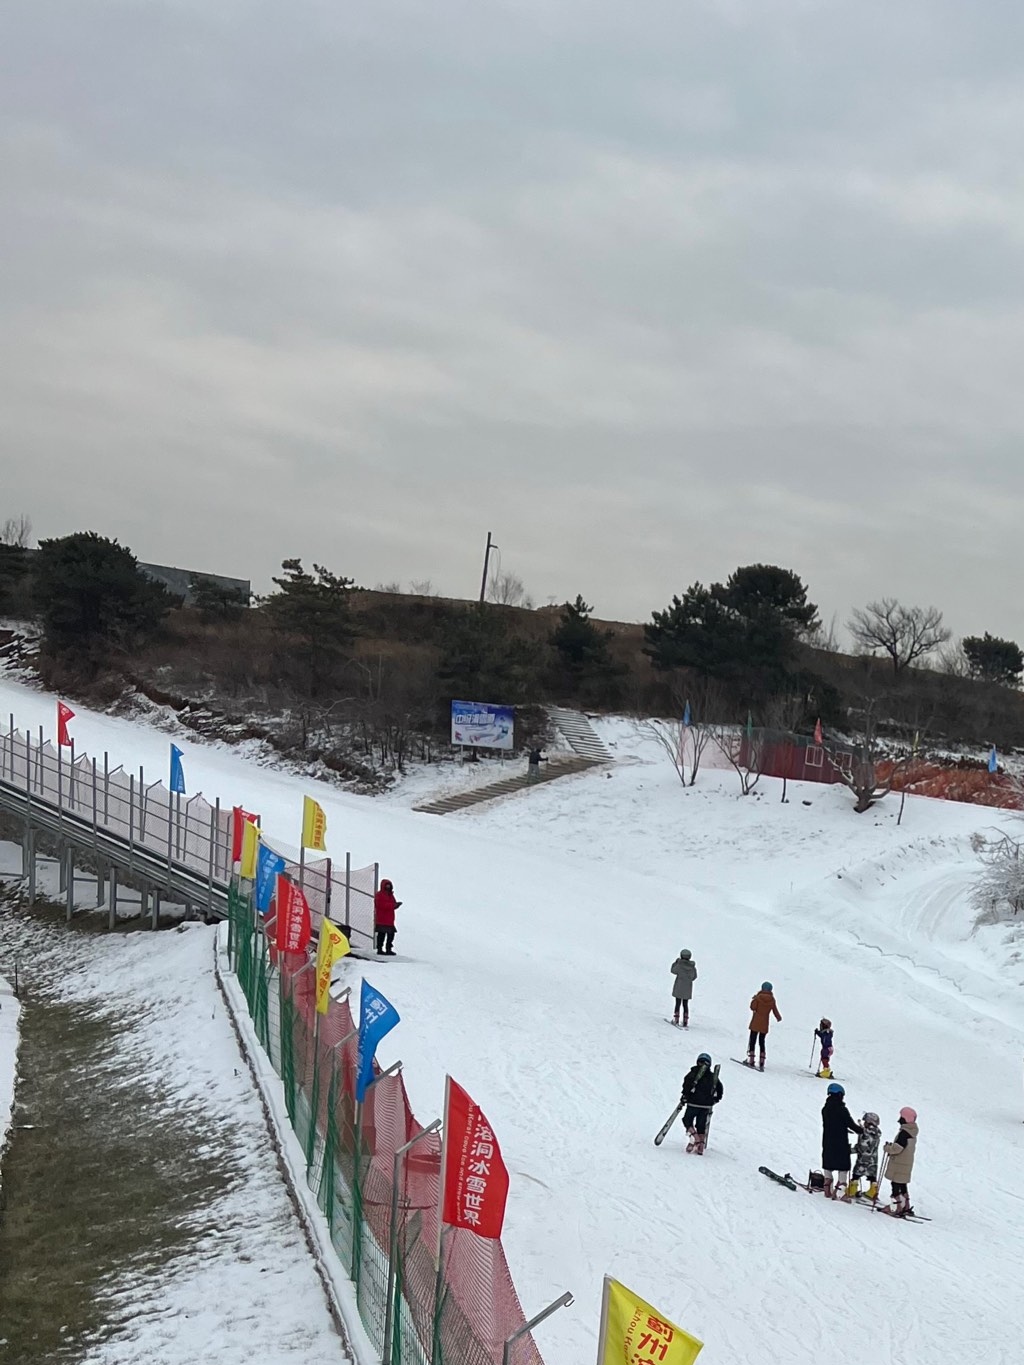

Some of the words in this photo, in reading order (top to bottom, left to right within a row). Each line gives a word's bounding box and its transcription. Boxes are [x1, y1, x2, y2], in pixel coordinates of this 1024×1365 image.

[463, 1114, 495, 1227] 溶洞冰雪世界
